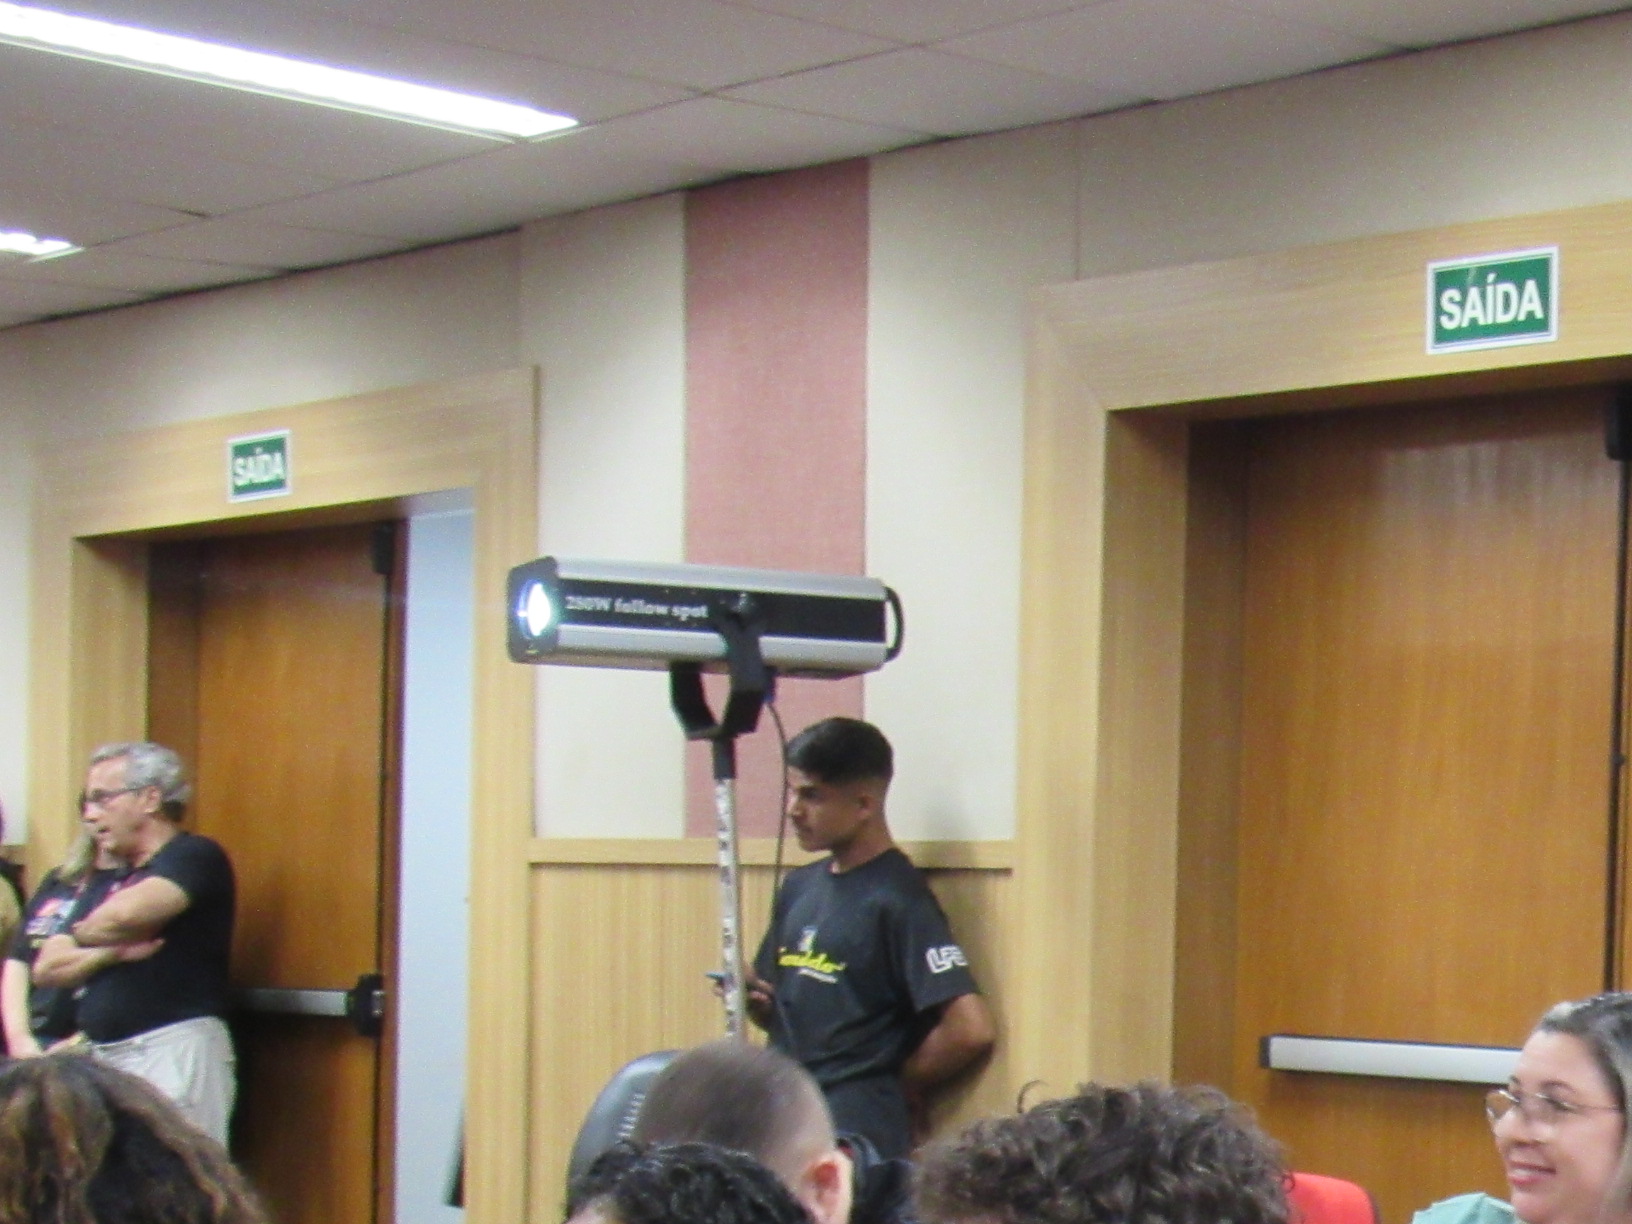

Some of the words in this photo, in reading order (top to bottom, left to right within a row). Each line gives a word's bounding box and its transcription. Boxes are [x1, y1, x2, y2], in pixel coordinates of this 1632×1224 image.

[1440, 273, 1544, 330] SAÍDA
[233, 447, 285, 487] SAÍDA
[614, 597, 669, 615] follow
[671, 604, 709, 622] spot
